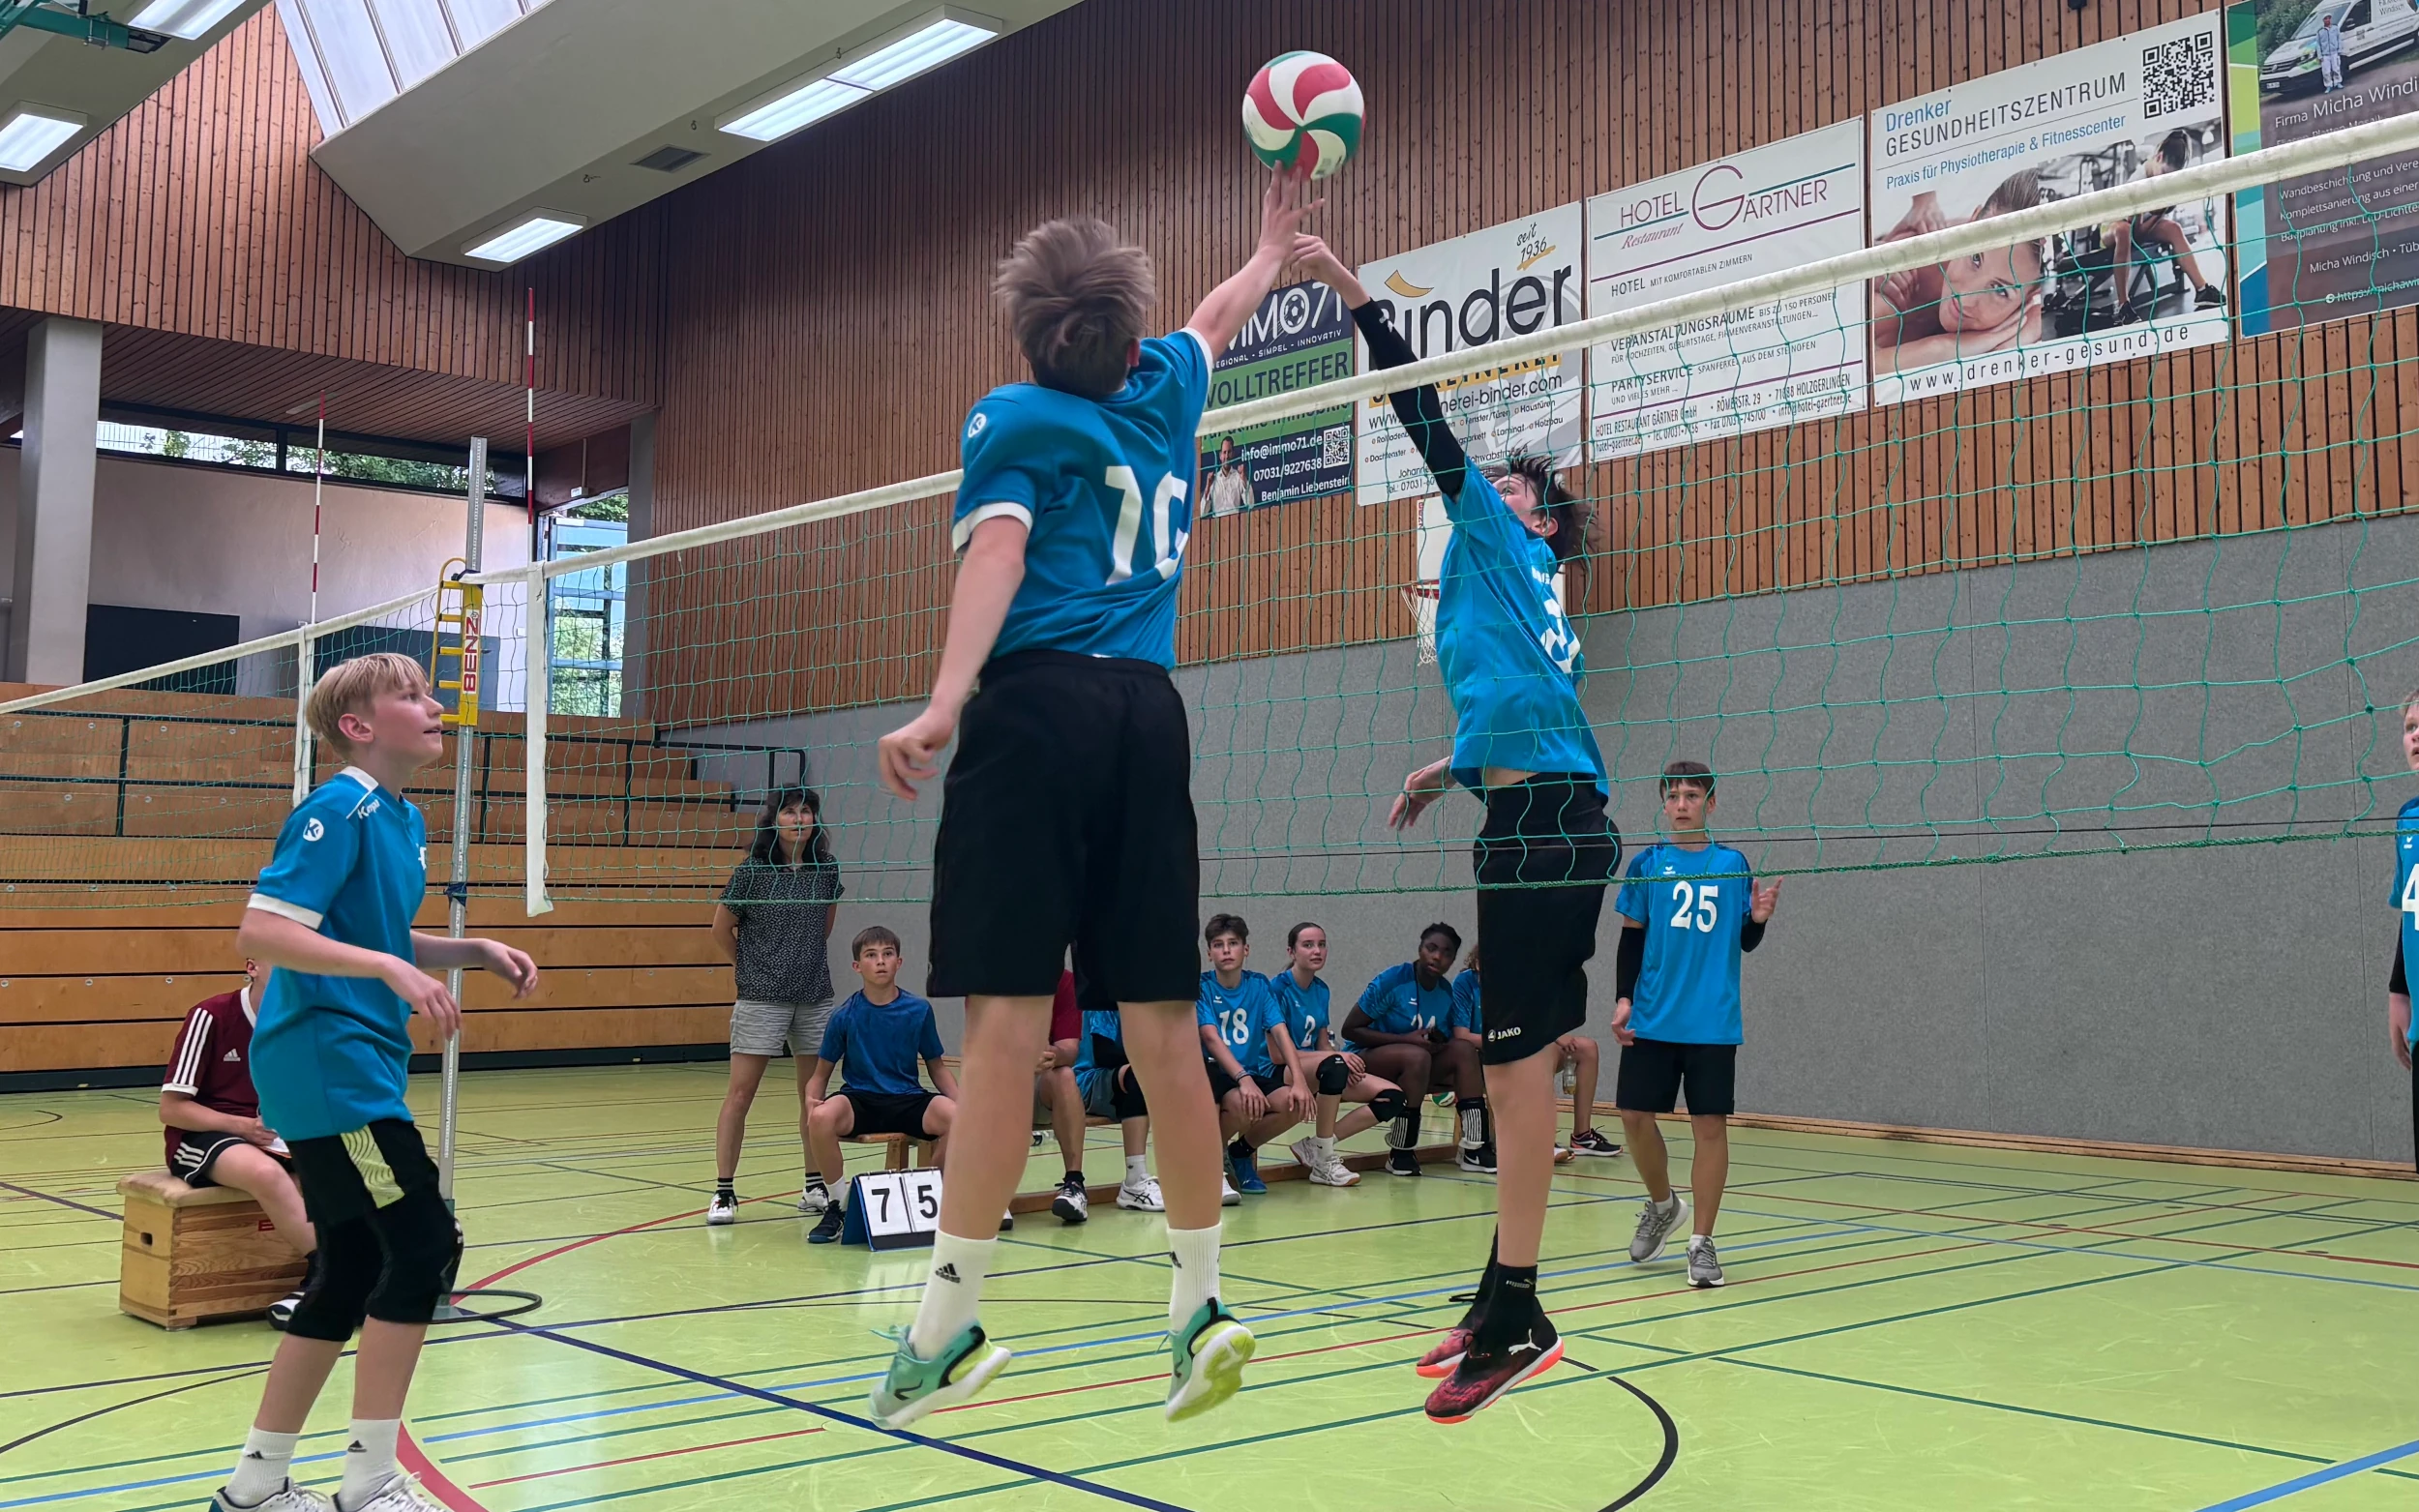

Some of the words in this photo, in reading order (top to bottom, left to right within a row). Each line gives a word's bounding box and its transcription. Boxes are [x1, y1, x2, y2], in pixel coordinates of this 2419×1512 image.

[1886, 72, 2126, 157] GESUNDHEITSZENTRUM
[1886, 99, 1952, 133] Drenker
[2275, 111, 2309, 129] Firma
[2313, 95, 2364, 119] Micha
[1887, 170, 1921, 190] Praxis
[1923, 164, 1938, 180] für
[1940, 141, 2025, 176] Physiotherapie
[2029, 136, 2039, 151] &
[2042, 114, 2127, 147] Fitnesscenter
[2373, 163, 2394, 178] und
[1621, 192, 1685, 228] HOTEL
[1692, 165, 1828, 230] GÄRTNER
[2373, 189, 2391, 199] aus
[2393, 182, 2419, 194] einer
[1516, 222, 1538, 247] seit
[1520, 236, 1547, 264] 1936
[1620, 222, 1685, 250] Restaurant
[1611, 277, 1646, 297] HOTEL
[1650, 277, 1662, 287] MIT
[1663, 263, 1717, 283] KOMFORTABLEN
[1718, 253, 1753, 270] ZIMMERN
[2309, 258, 2341, 274] Micha
[2342, 248, 2390, 267] Windisch
[1759, 307, 1771, 317] BIS
[1784, 300, 1798, 311] 150
[1213, 354, 1249, 369] EGIONAL
[1258, 343, 1288, 358] SIMPEL
[1297, 328, 1343, 347] INNOVATIV
[1611, 353, 1625, 365] FÜR
[1909, 325, 2190, 392] www.drenker-gesund.de
[1207, 351, 1349, 409] VOLLTREFFER
[1611, 366, 1694, 393] PARTYSERVICE
[1742, 355, 1756, 365] AUS
[1757, 349, 1775, 361] DEM
[1596, 425, 1613, 437] HOTEL
[1652, 409, 1679, 427] GÄRTNER
[1752, 392, 1761, 405] 29
[1796, 373, 1851, 397] HOLZGERLINGEN
[1611, 395, 1626, 405] UND
[1650, 385, 1670, 397] MEHR
[1261, 484, 1299, 502] Benjamin
[463, 616, 480, 693] BENZ
[1670, 879, 1718, 934] 25
[1218, 1007, 1250, 1047] 18
[1300, 1014, 1317, 1048] 2
[1497, 1026, 1522, 1040] JAKO
[871, 1187, 891, 1223] 7
[917, 1184, 939, 1219] 5
